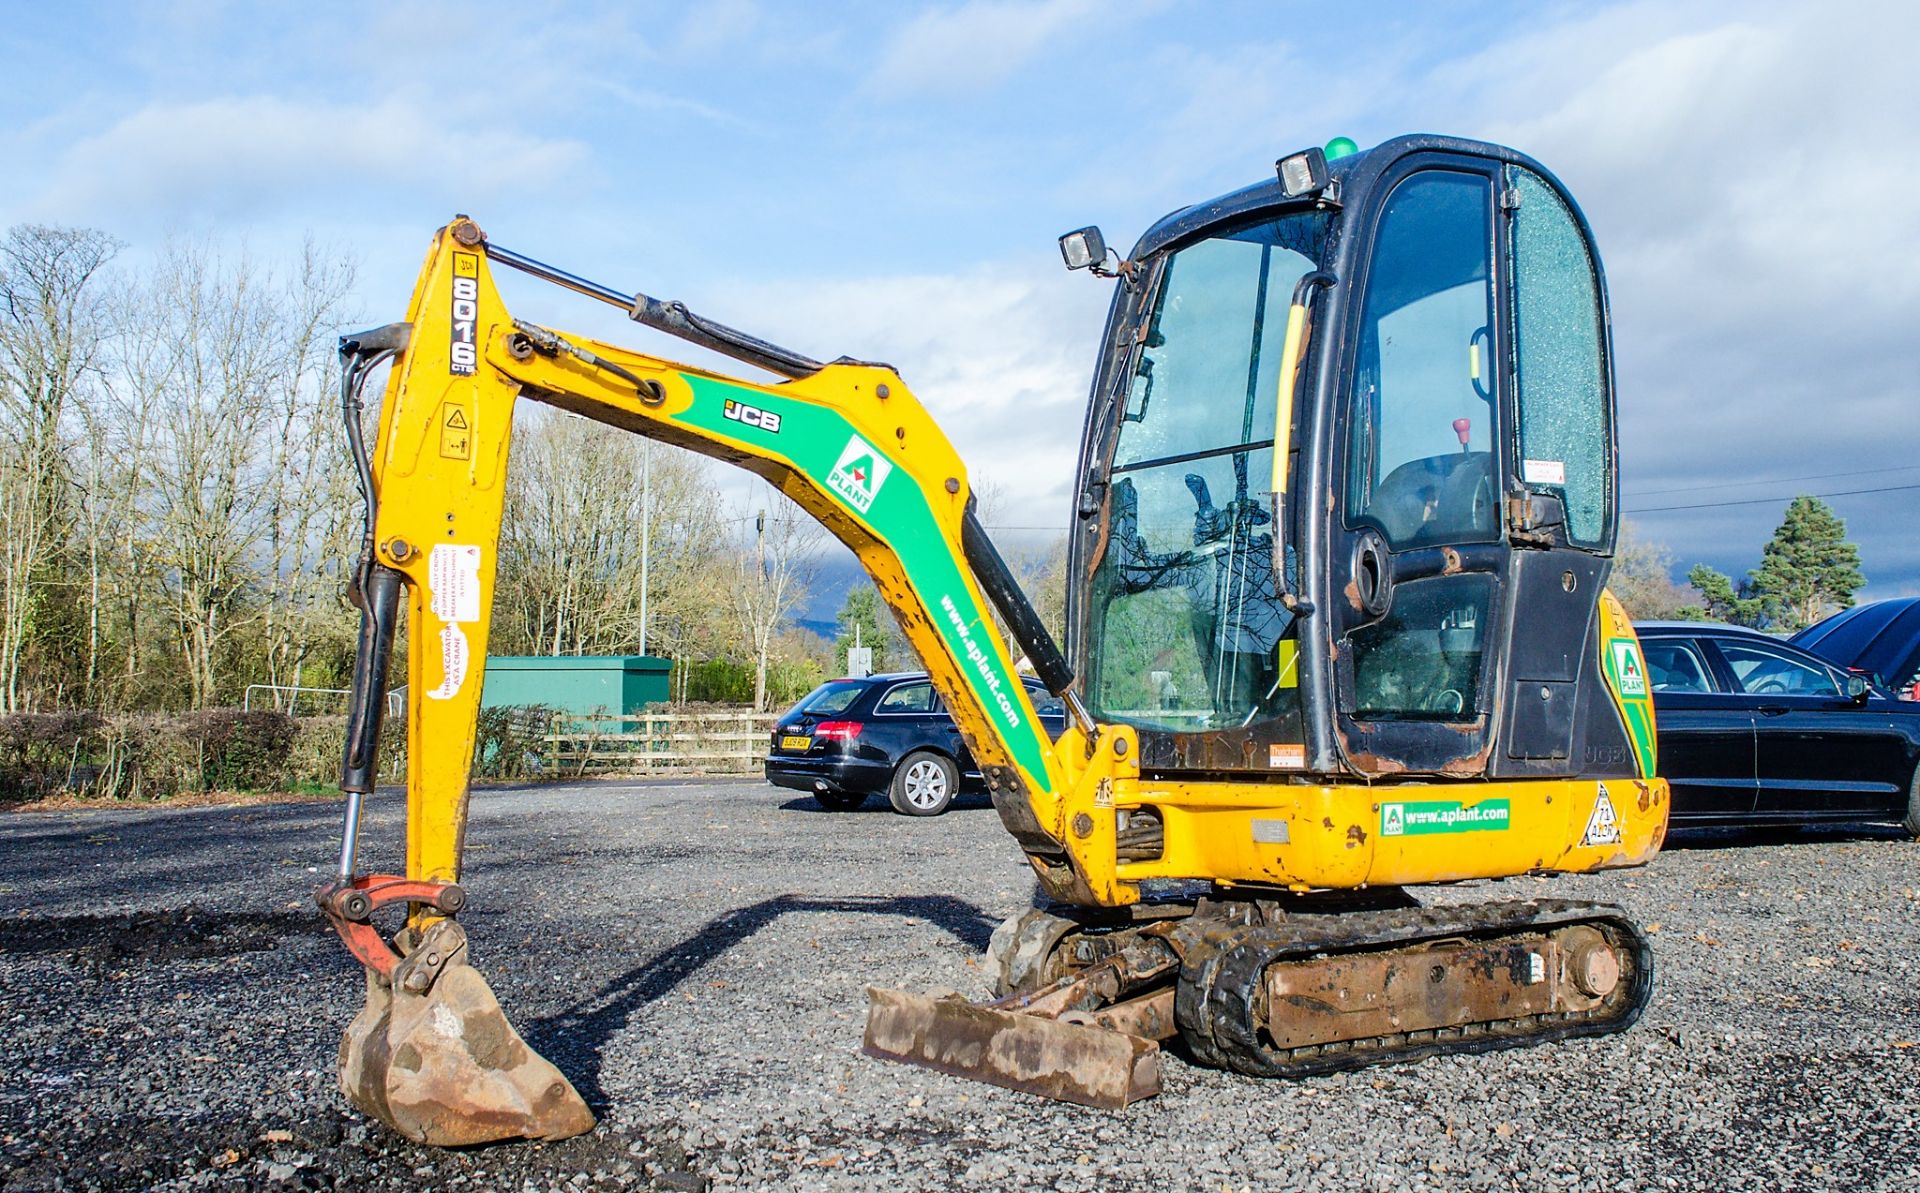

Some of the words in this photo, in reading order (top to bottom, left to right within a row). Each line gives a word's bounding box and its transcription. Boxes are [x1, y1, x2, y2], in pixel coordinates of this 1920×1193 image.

[452, 278, 476, 365] 8016
[724, 402, 781, 433] JCB
[829, 473, 870, 509] PLANT
[444, 625, 452, 675] EXCAVATOR
[453, 637, 461, 666] CRANE
[940, 595, 1021, 728] www.aplant.com
[454, 674, 460, 686] AS
[1622, 679, 1644, 690] PLANT
[1405, 807, 1508, 826] www.aplant.com
